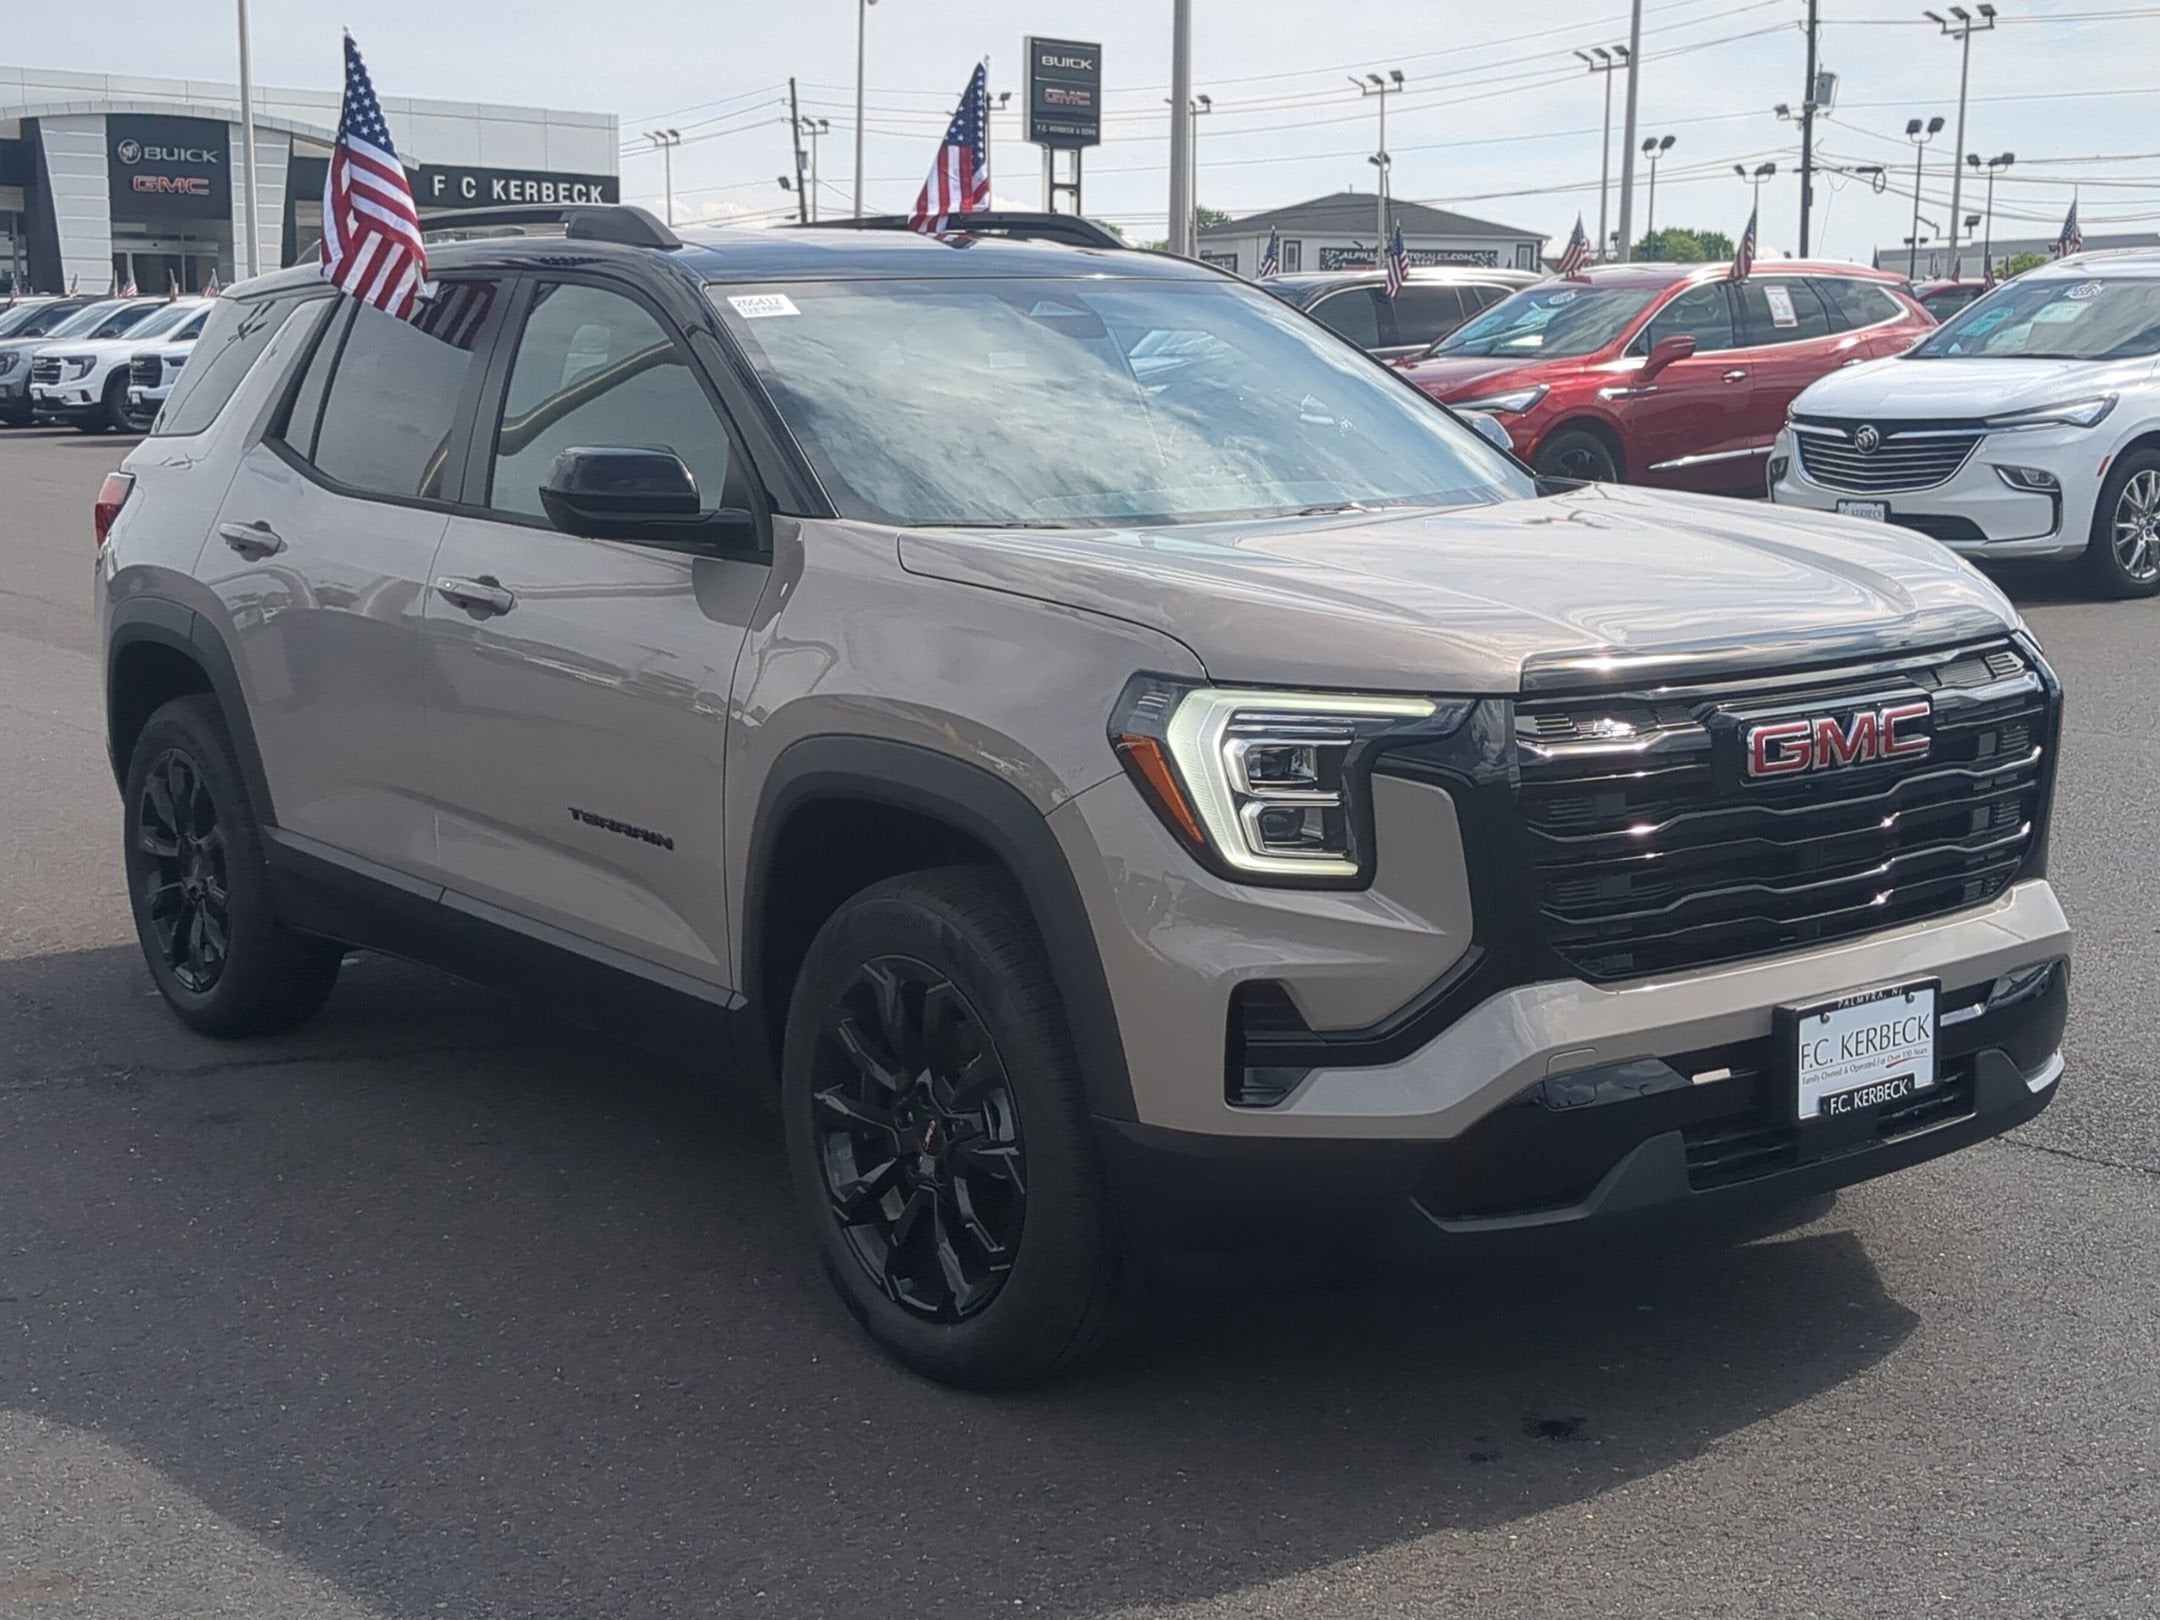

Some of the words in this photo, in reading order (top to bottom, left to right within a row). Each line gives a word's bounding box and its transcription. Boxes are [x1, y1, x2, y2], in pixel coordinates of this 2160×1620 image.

[1042, 55, 1093, 70] BUICK
[1045, 88, 1091, 106] GMC
[144, 147, 219, 163] BUICK
[133, 175, 210, 195] GMC
[433, 175, 446, 196] F
[462, 176, 477, 198] C
[492, 179, 603, 204] KERBECK
[1747, 701, 1931, 777] GMC
[567, 807, 674, 851] TERRAIN
[1801, 1038, 1833, 1070] F.C.
[1841, 1013, 1931, 1061] KERBECK
[1802, 1074, 1820, 1085] Family
[1821, 1067, 1842, 1080] Owned
[1843, 1065, 1849, 1075] &
[1850, 1057, 1876, 1073] Operated
[1887, 1053, 1901, 1063] Over
[1830, 1095, 1850, 1115] F.C.
[1854, 1079, 1908, 1109] KERBECK
